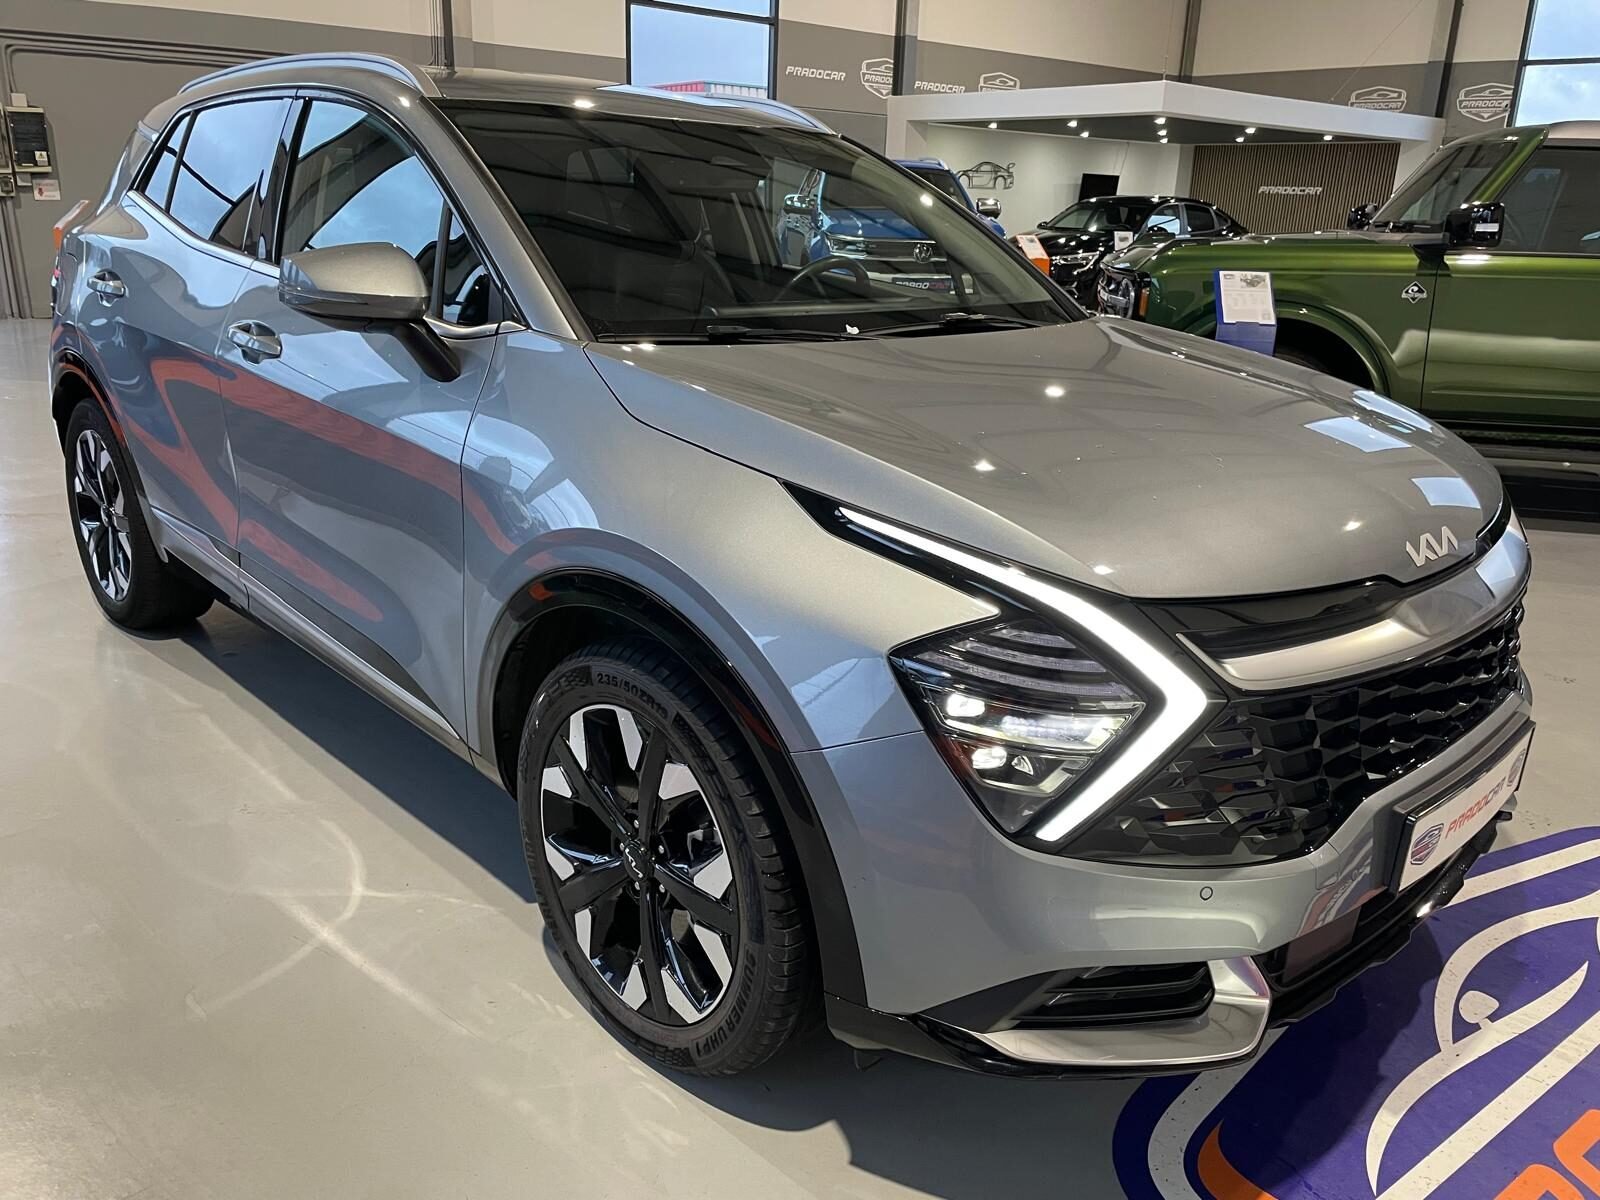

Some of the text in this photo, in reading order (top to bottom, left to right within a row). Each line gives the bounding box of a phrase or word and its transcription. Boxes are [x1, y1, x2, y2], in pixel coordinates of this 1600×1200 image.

[785, 65, 846, 82] PRADOCAR
[864, 74, 893, 84] PRADO
[914, 80, 966, 94] PRADOCAR
[1460, 99, 1510, 108] PRADOC
[1258, 185, 1322, 195] PRADOCAR
[1405, 526, 1458, 567] KIA
[1445, 776, 1506, 840] PRADOCAR
